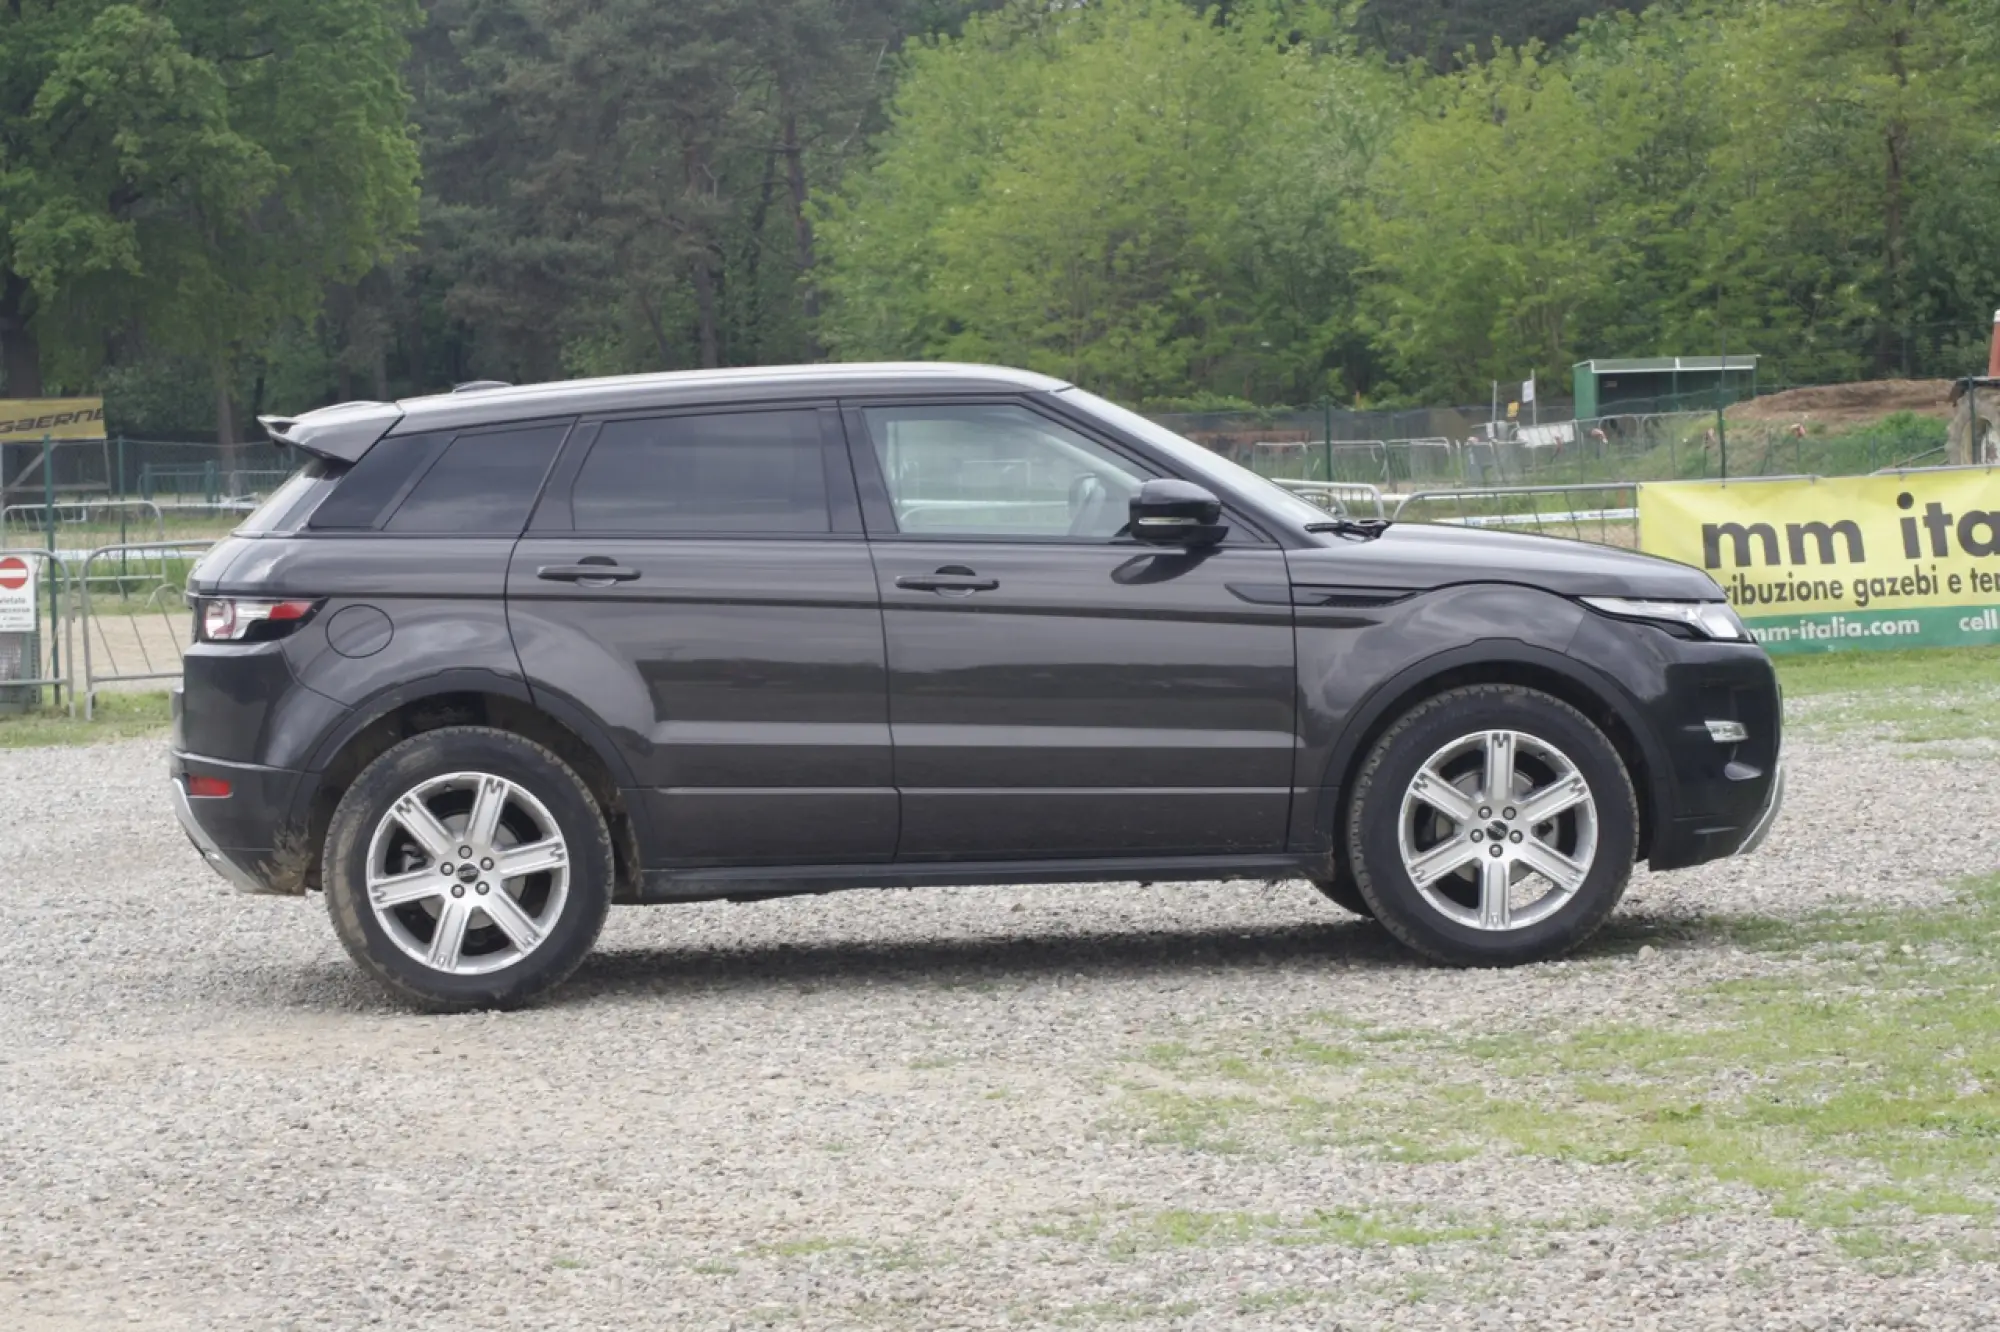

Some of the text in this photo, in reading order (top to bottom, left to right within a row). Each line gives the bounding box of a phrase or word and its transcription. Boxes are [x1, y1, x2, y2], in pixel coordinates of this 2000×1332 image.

[1702, 492, 2000, 569] mm ita
[1853, 564, 1939, 607] gazebi
[1948, 573, 1962, 594] e
[1958, 608, 1998, 631] cell
